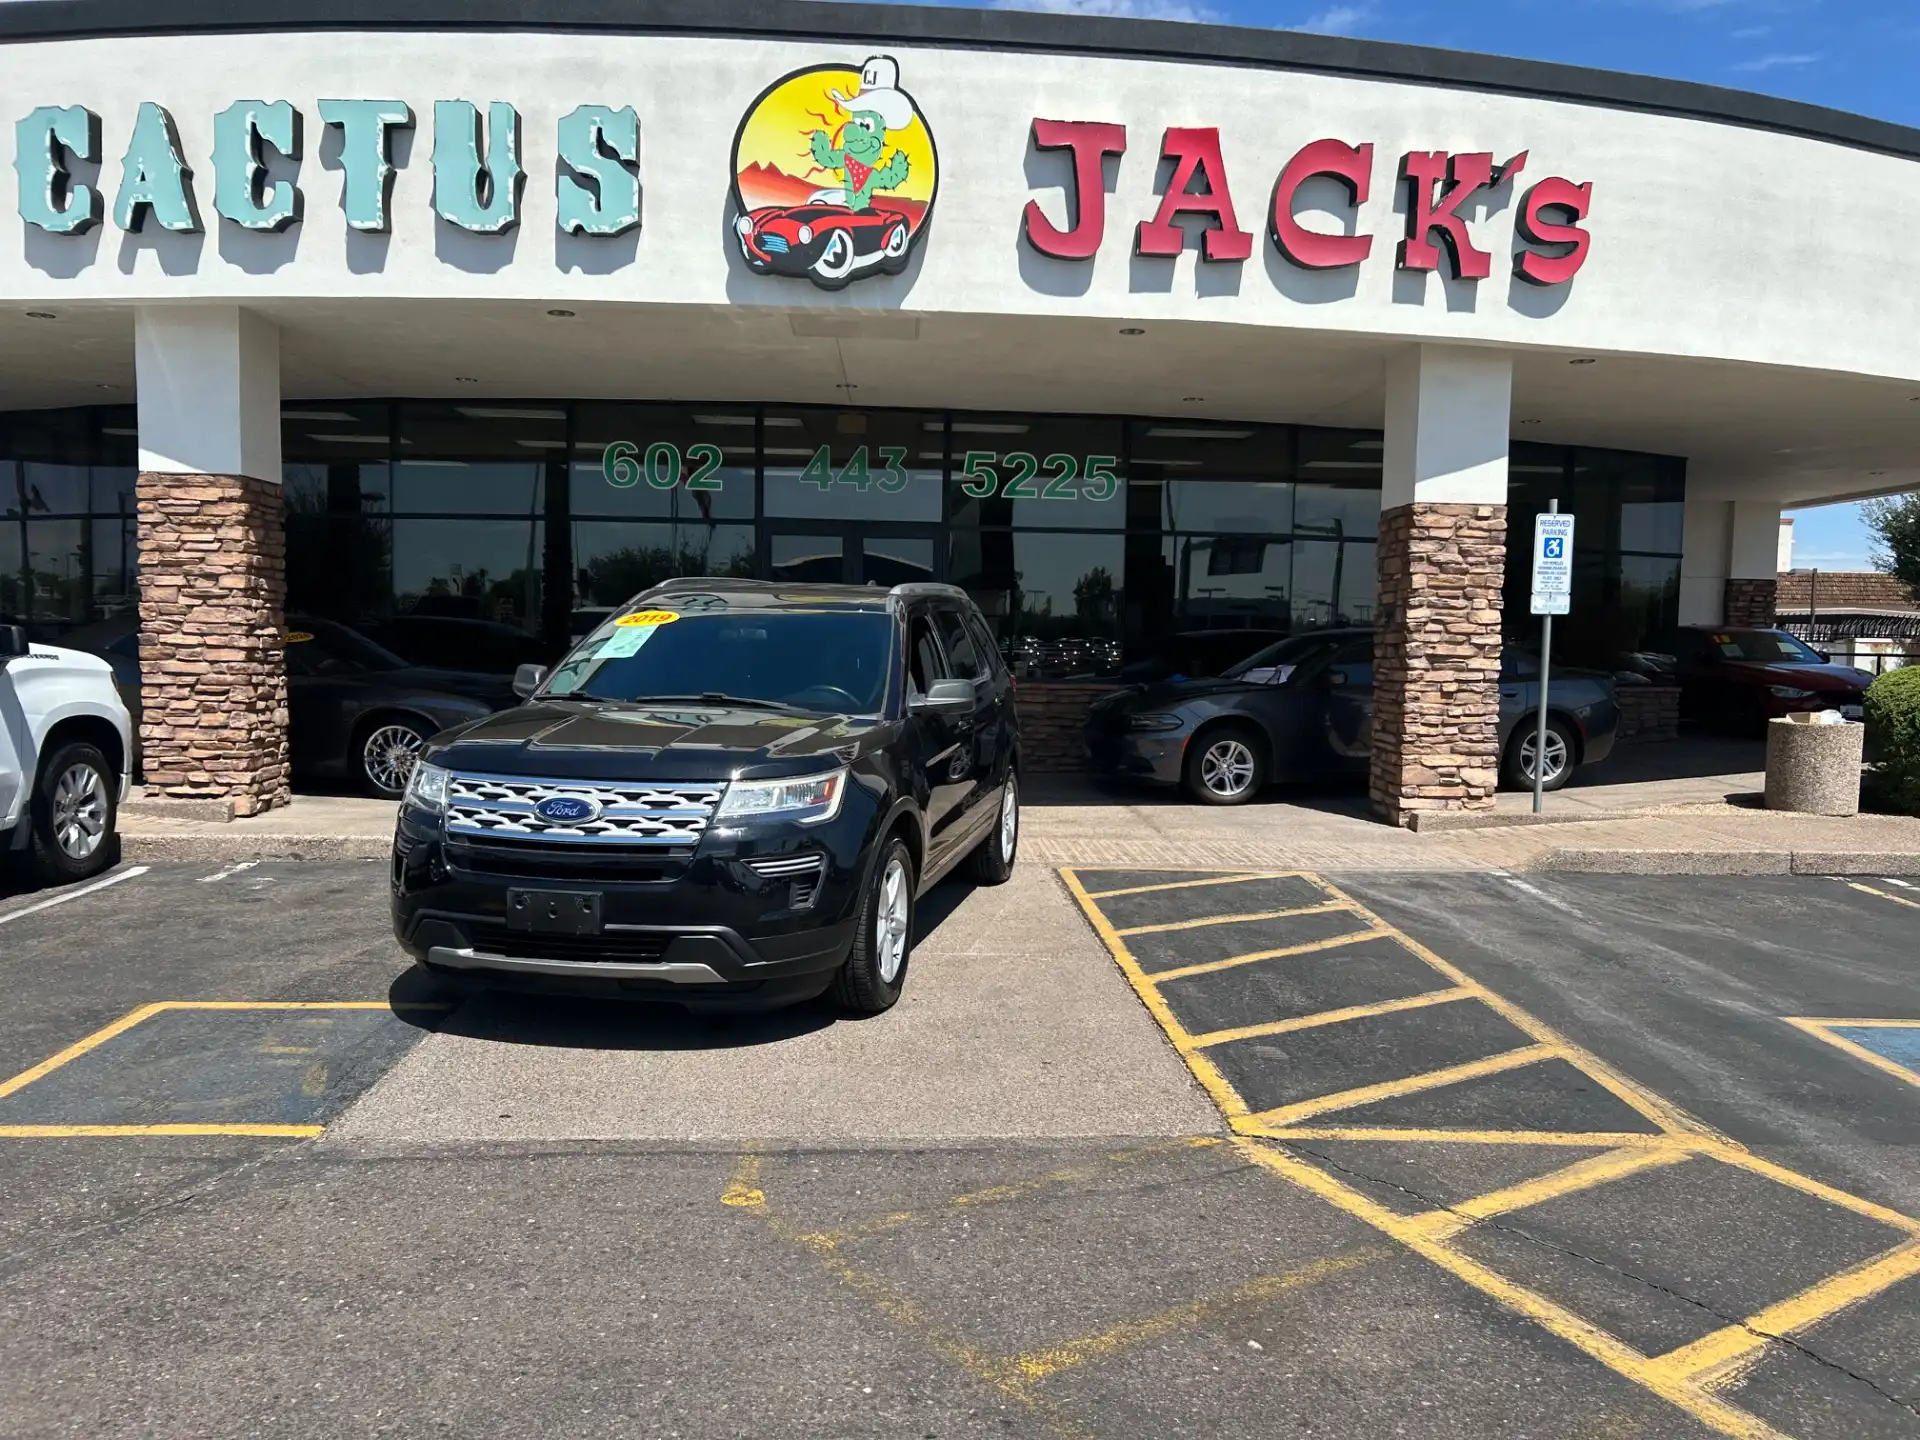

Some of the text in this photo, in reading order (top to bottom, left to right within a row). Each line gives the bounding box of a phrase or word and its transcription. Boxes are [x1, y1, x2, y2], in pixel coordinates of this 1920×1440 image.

[863, 69, 878, 86] CJ
[12, 98, 643, 236] CACTUS
[602, 440, 1119, 502] 602 443 5225
[1539, 519, 1571, 528] RESERVED
[1542, 528, 1568, 537] PARKING
[619, 613, 673, 625] 2019
[546, 800, 581, 816] Ford
